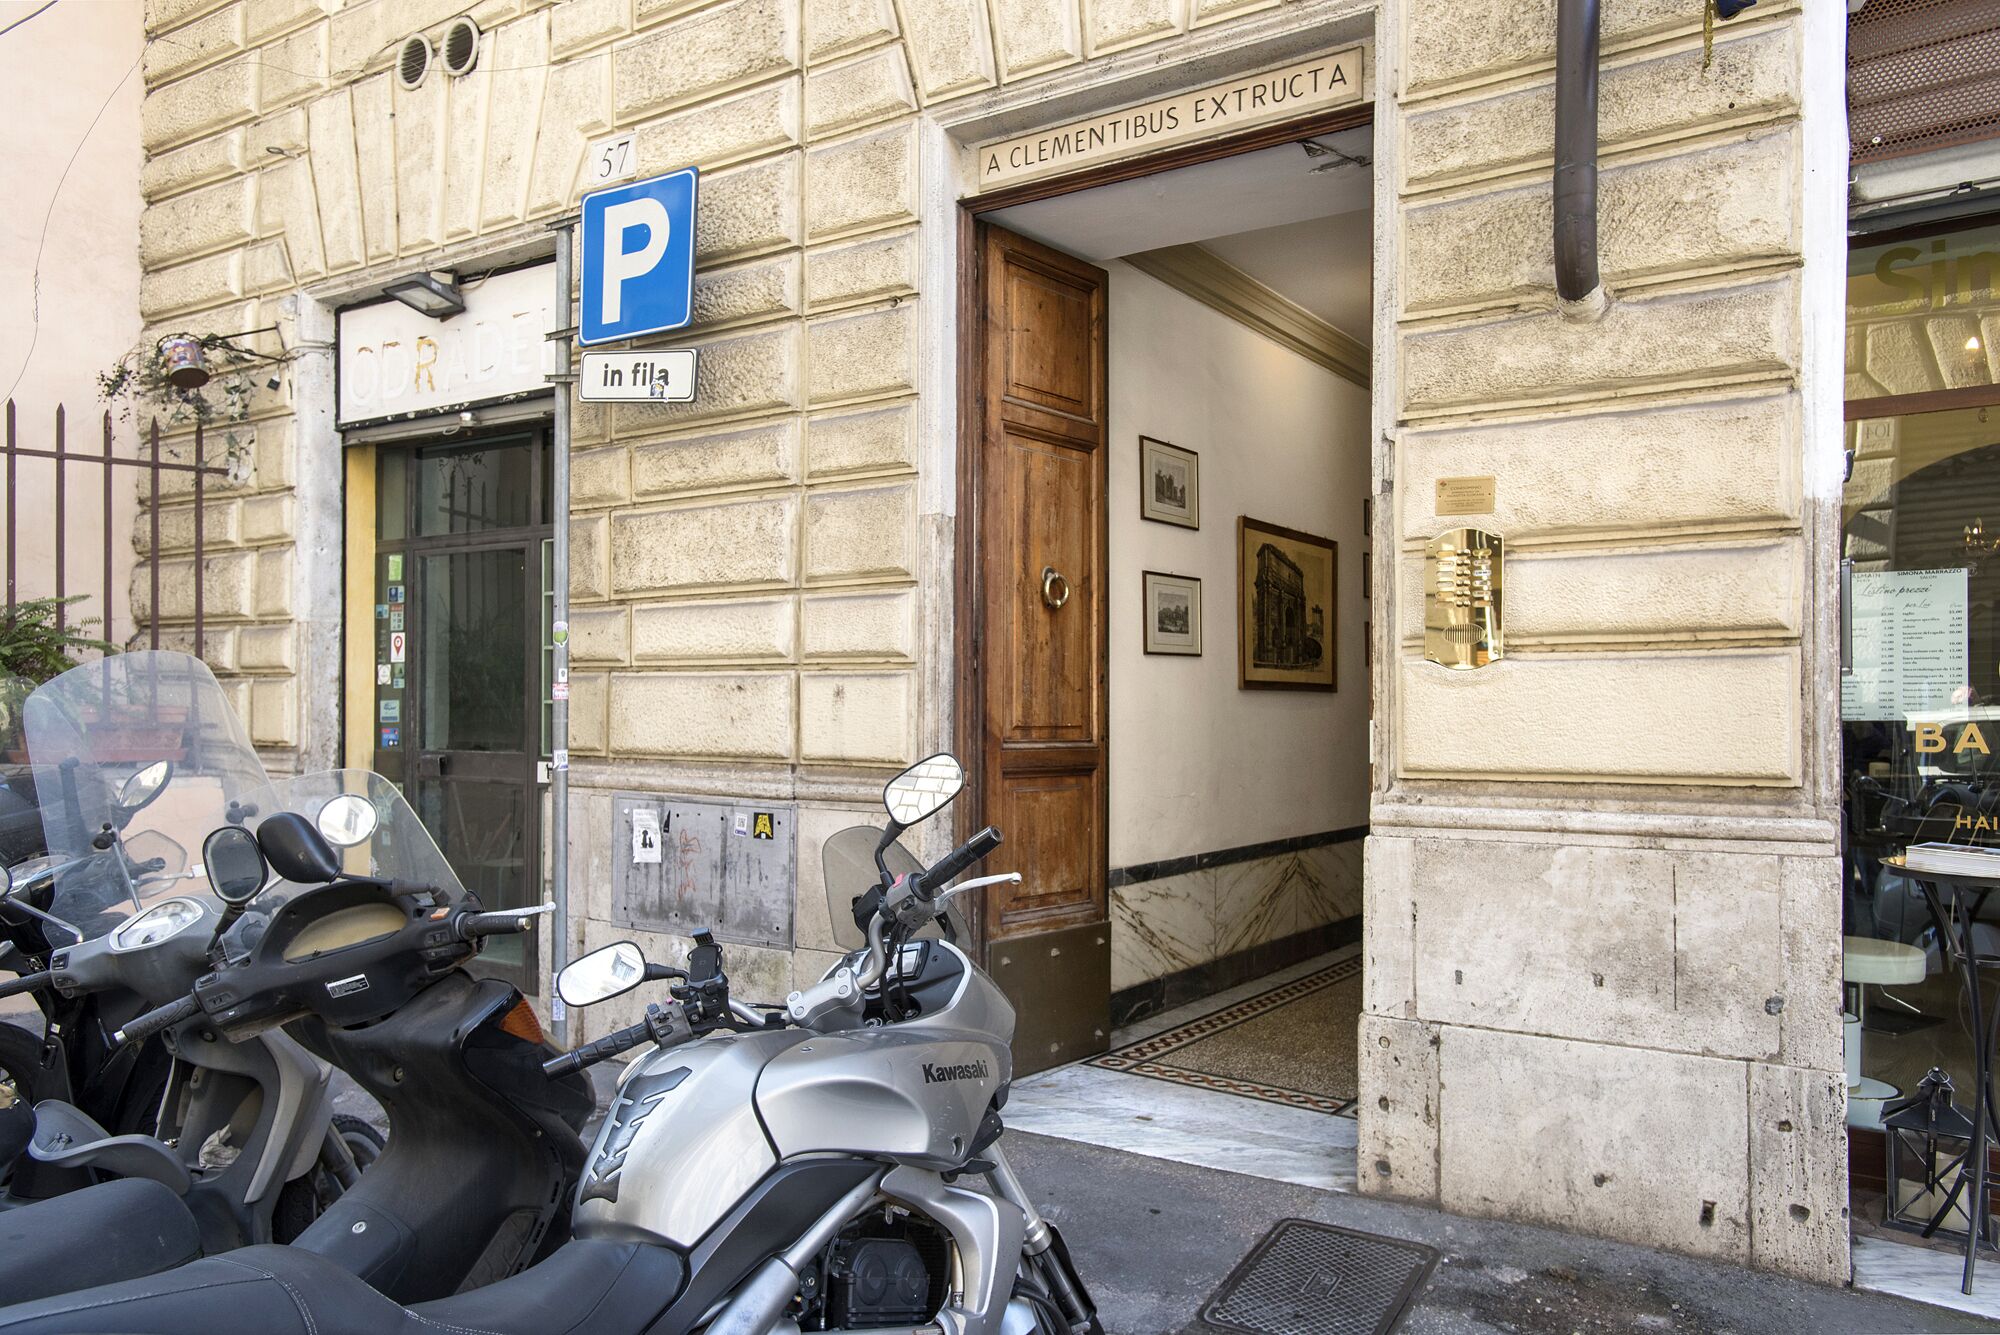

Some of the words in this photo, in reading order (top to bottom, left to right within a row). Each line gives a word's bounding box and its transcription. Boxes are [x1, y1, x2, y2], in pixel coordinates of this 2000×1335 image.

[986, 153, 1001, 176] A
[1010, 106, 1179, 169] CLEMENTIBUS
[1194, 63, 1348, 124] EXTRUCTA
[600, 140, 630, 178] 57
[602, 197, 670, 325] P
[603, 363, 623, 387] in
[631, 362, 670, 387] fila
[1924, 568, 1962, 576] MARRAZZO
[1857, 583, 1895, 597] Listino
[1895, 584, 1933, 598] prezzi
[1915, 722, 1991, 754] BA
[1956, 815, 1999, 831] HAI
[921, 1059, 989, 1084] Kawasaki
